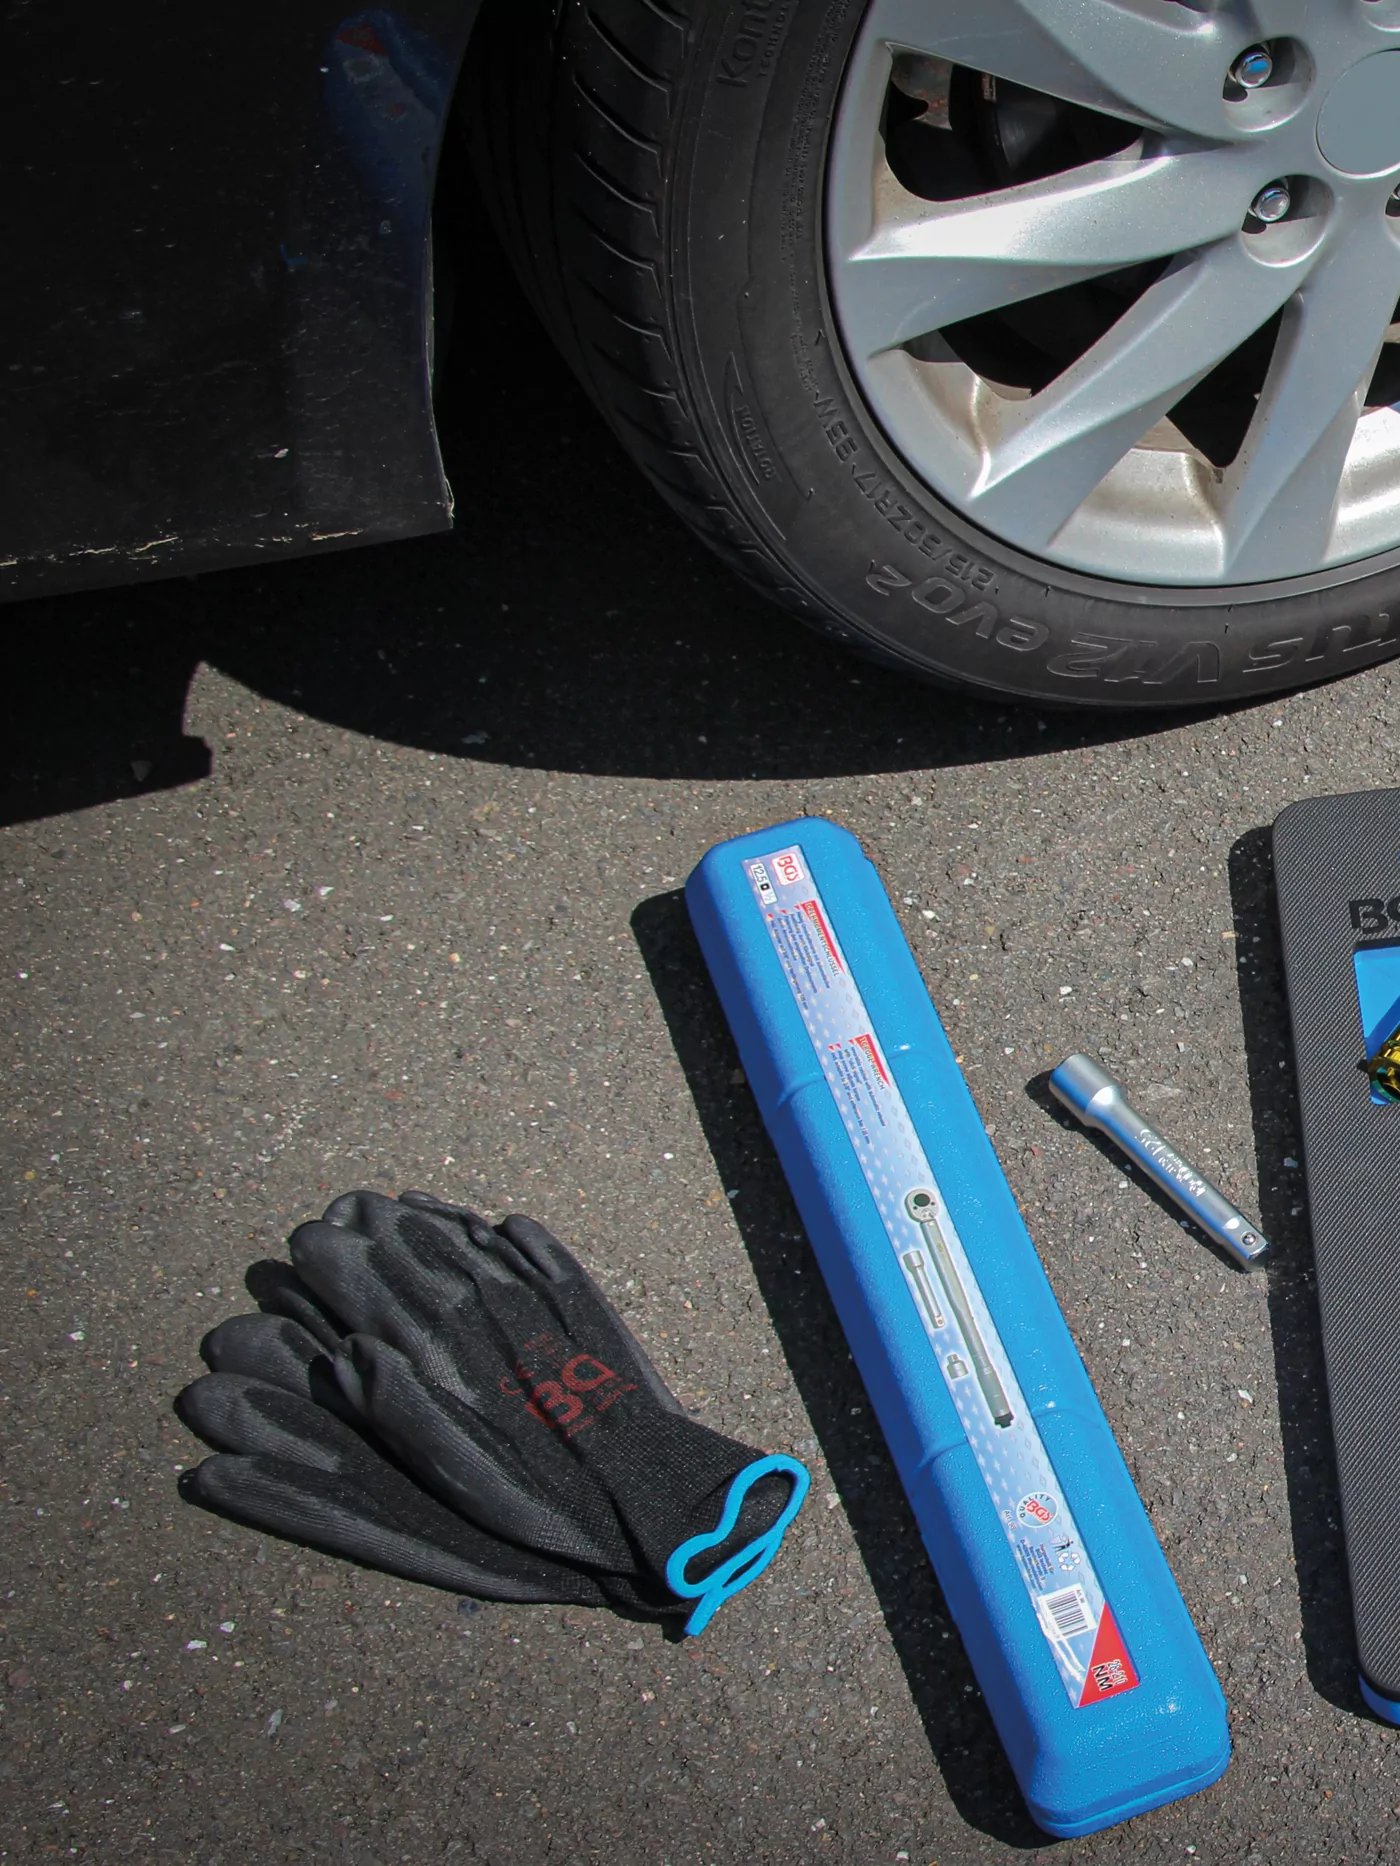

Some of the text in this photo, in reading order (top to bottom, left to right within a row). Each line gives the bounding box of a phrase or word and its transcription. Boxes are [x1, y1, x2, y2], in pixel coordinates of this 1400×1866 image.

[775, 853, 800, 883] BGS
[870, 1063, 885, 1090] WRENCH
[1018, 1494, 1051, 1518] QUALITY
[1026, 1499, 1050, 1521] BGS
[1091, 1663, 1113, 1692] NM
